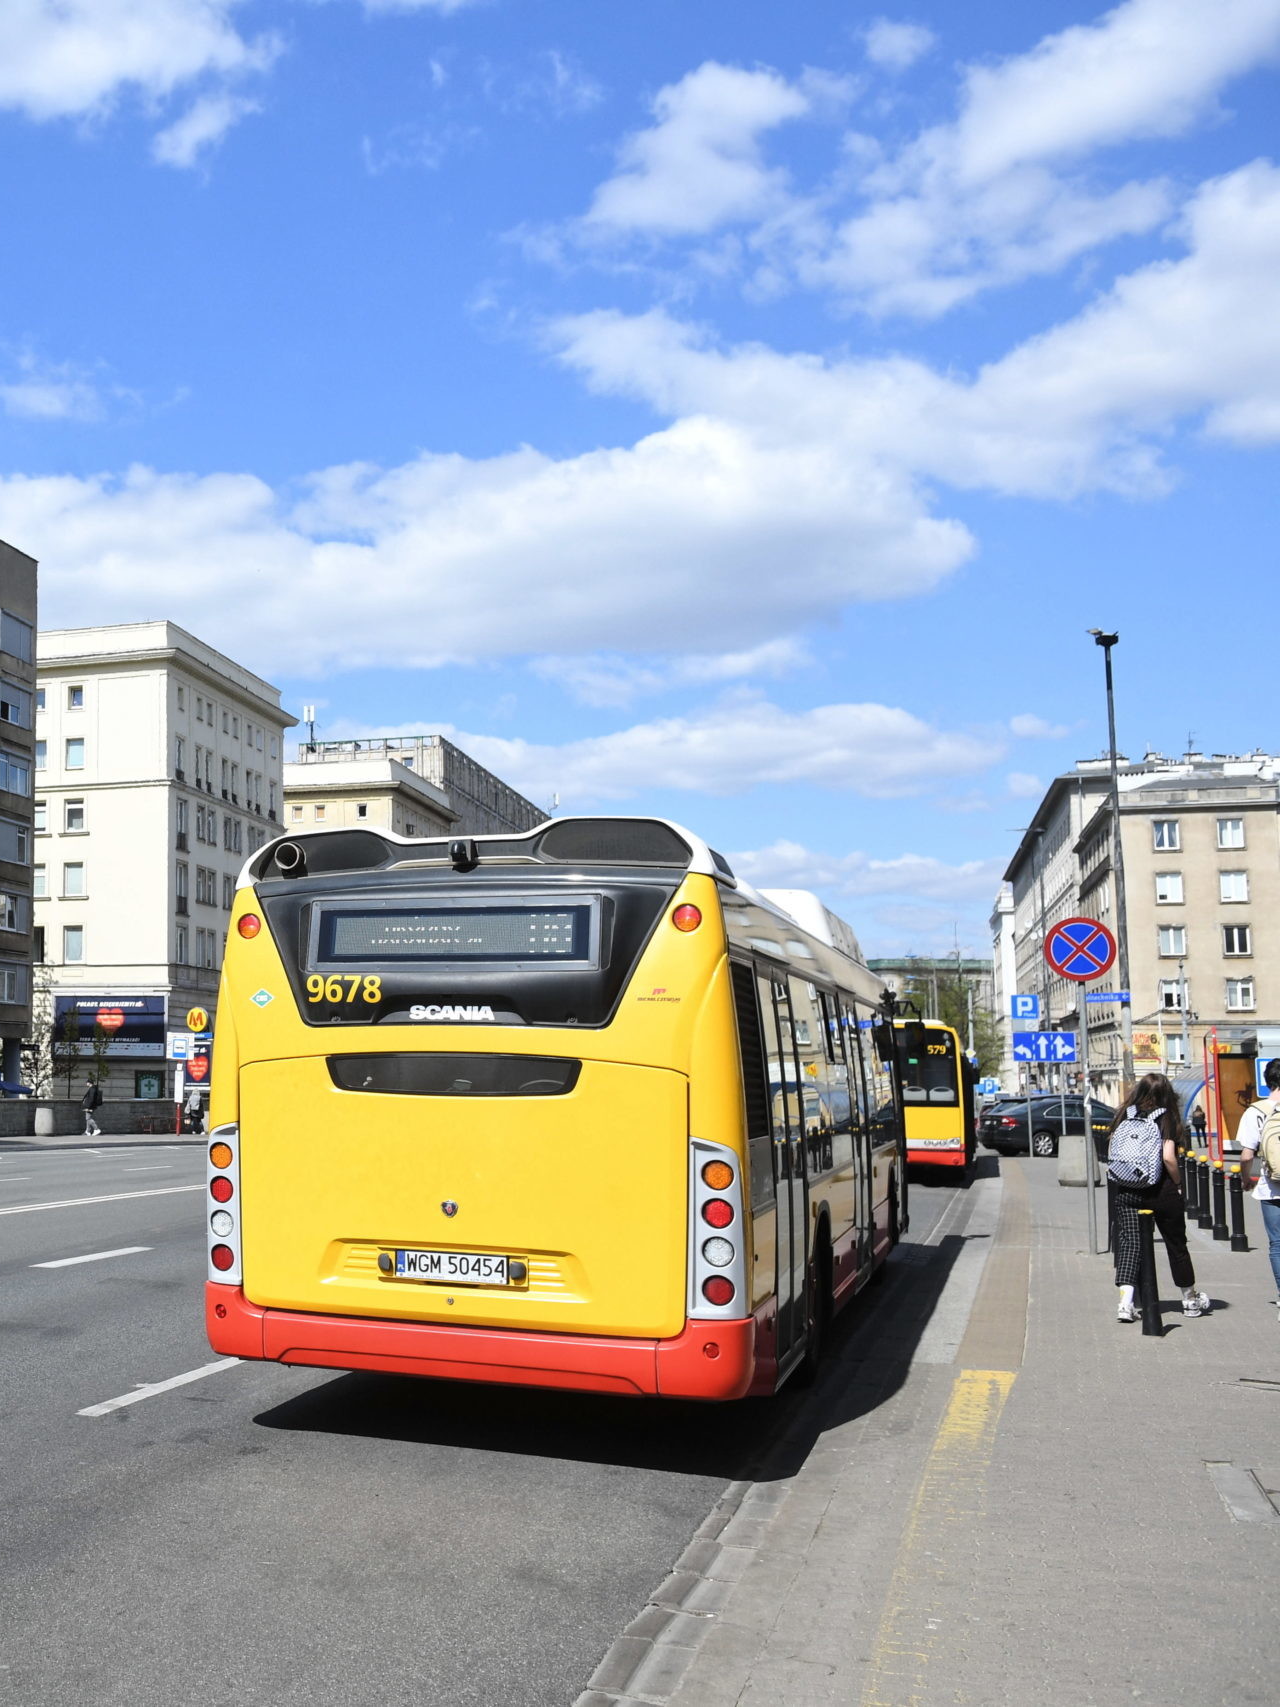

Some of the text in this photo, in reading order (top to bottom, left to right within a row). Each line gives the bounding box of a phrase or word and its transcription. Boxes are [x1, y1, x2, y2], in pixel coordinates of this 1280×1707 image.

[306, 974, 382, 1003] 9678
[409, 1005, 495, 1021] SCANIA
[927, 1045, 947, 1055] 579
[406, 1253, 505, 1278] WGM 50454
